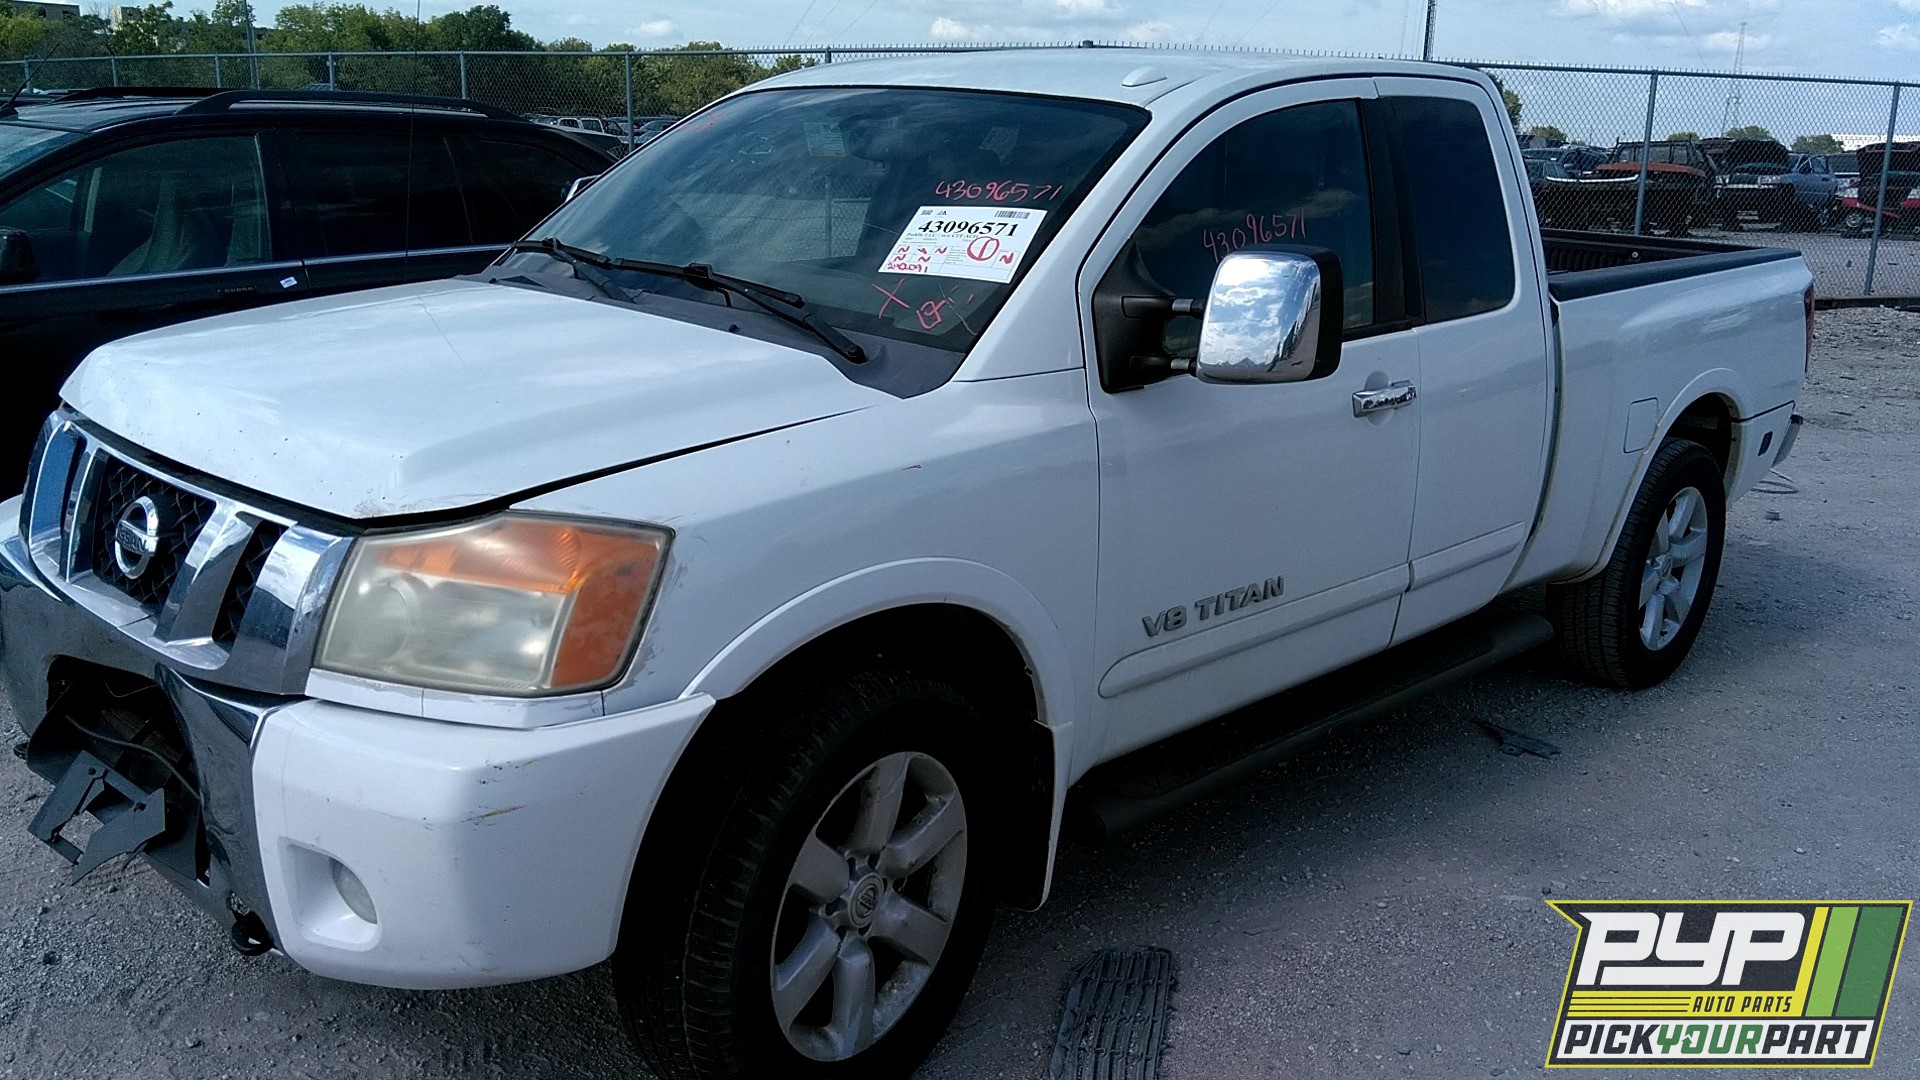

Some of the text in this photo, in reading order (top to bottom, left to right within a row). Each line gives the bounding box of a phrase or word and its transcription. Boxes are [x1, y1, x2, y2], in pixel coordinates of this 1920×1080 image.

[935, 180, 1063, 203] 43096571
[918, 220, 1019, 237] 43096571
[1203, 207, 1306, 265] 43096571
[1141, 575, 1285, 637] V8 TITAN
